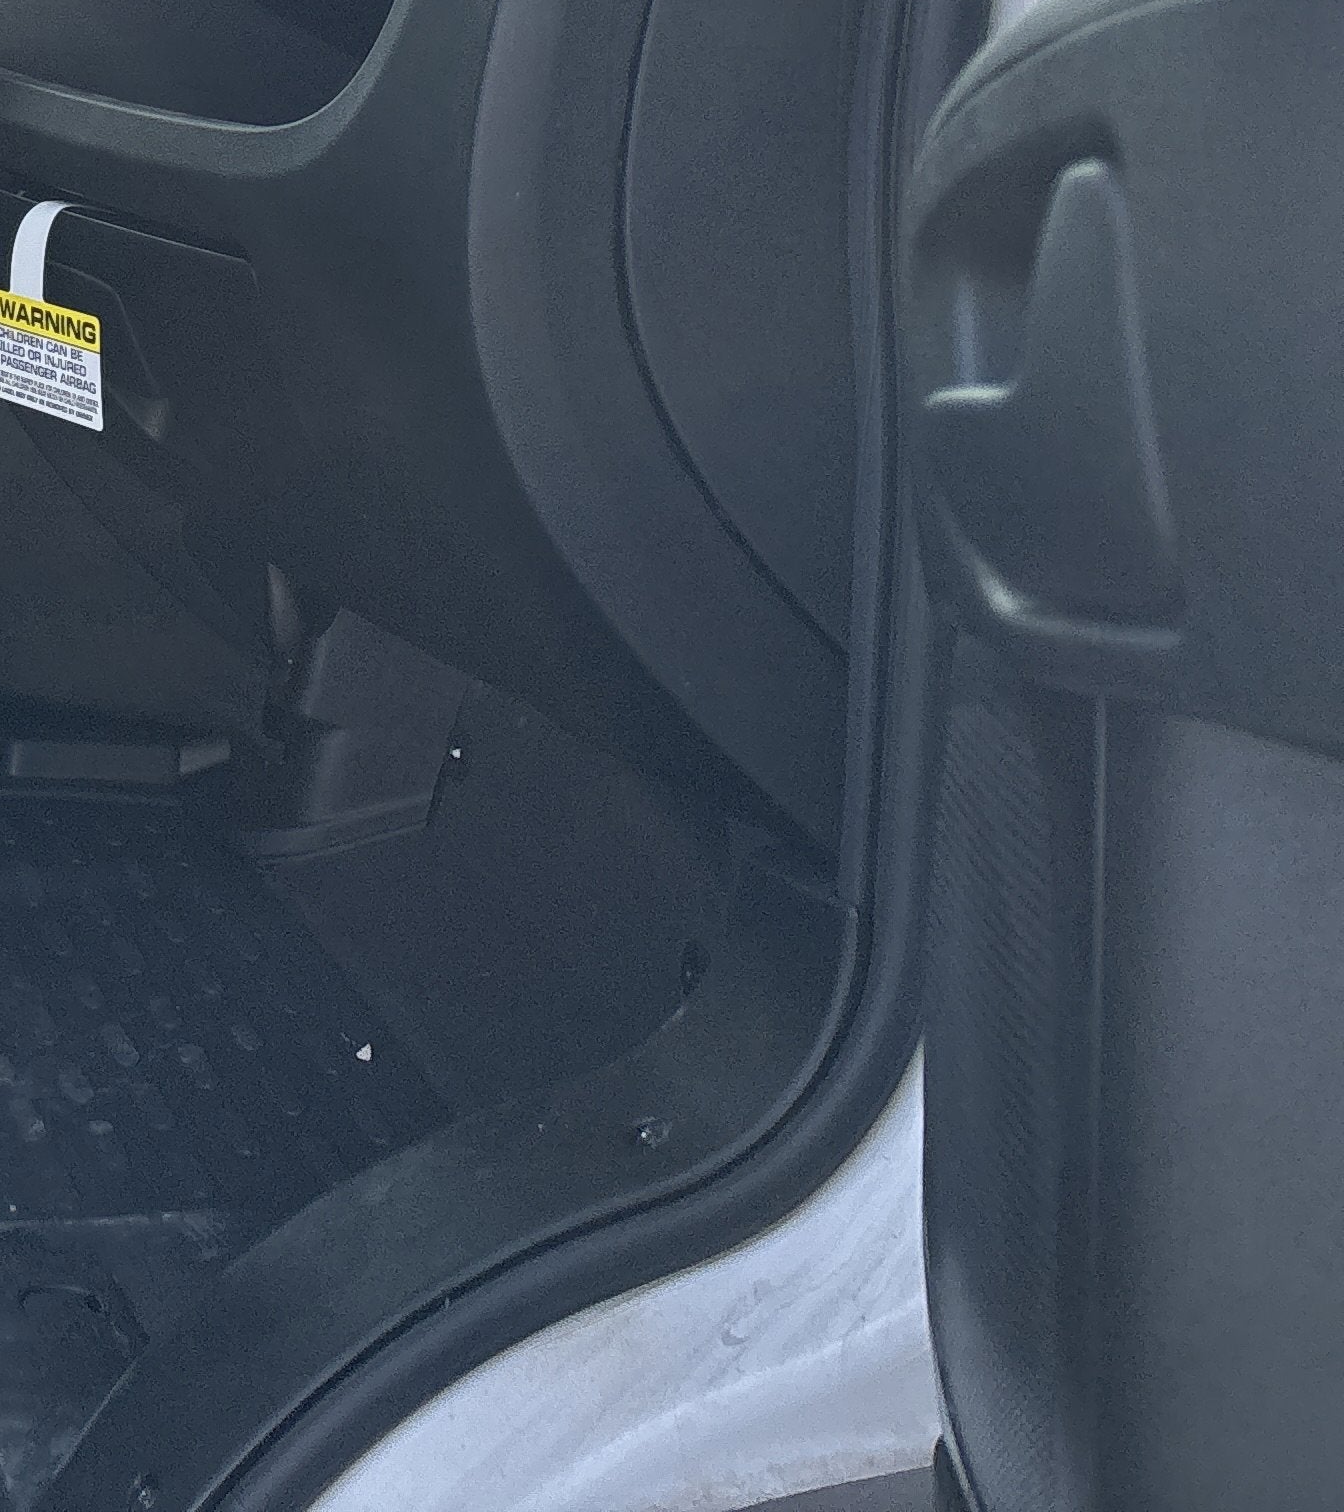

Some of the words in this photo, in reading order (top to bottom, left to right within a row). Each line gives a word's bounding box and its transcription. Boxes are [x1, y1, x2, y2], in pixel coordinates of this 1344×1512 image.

[0, 296, 96, 345] WARNING
[27, 349, 42, 364] OR
[44, 353, 87, 377] INJURED
[45, 340, 68, 359] CAN
[70, 348, 84, 363] BE
[0, 354, 58, 382] PASSENGER
[59, 373, 97, 394] AIRBAG
